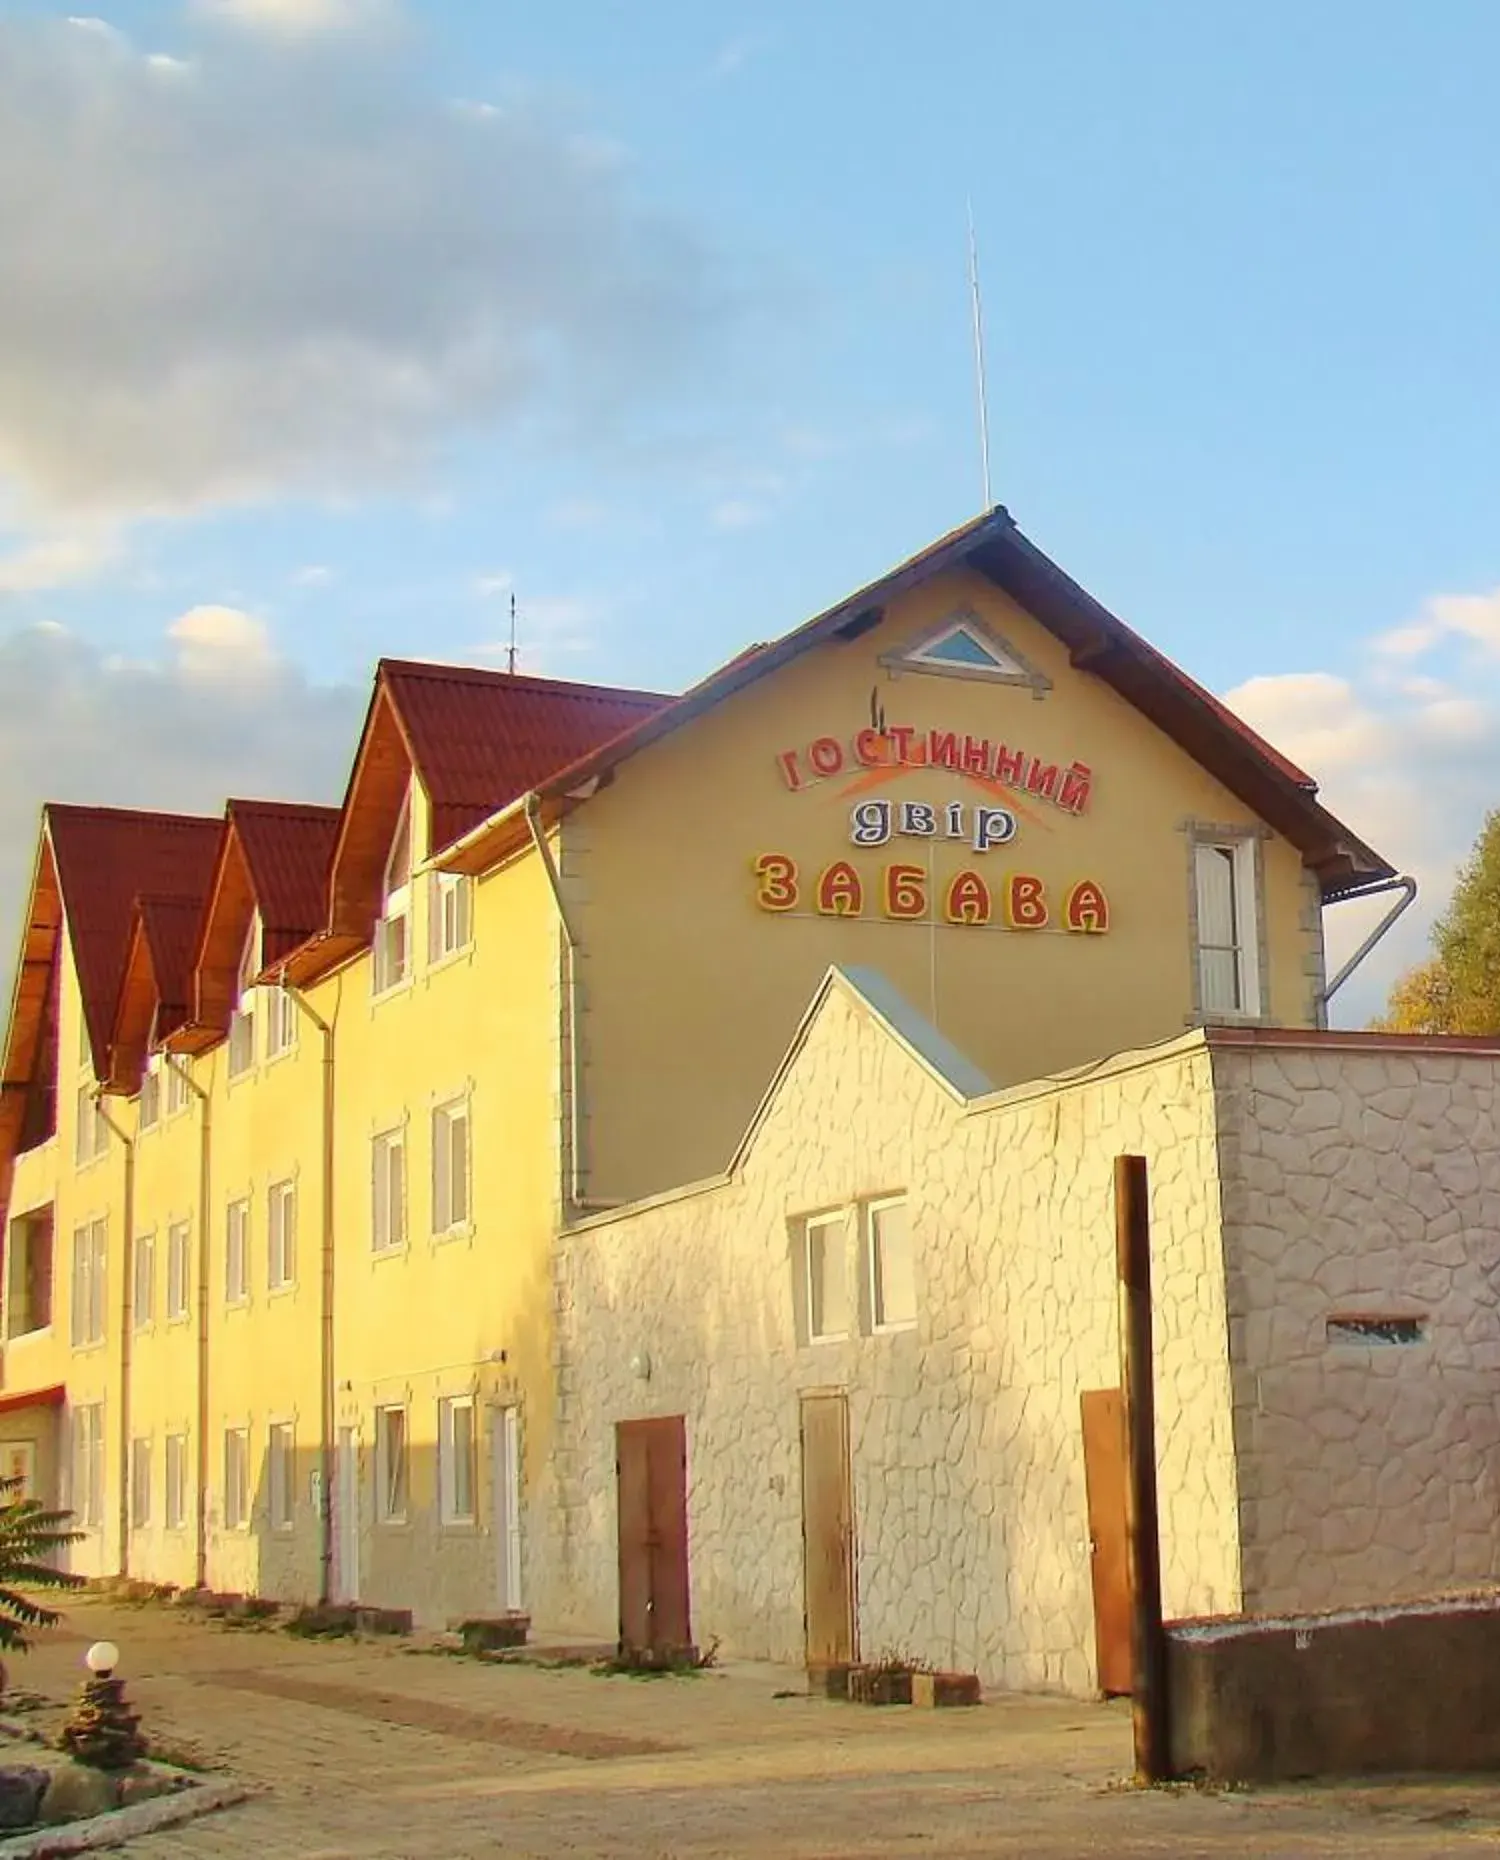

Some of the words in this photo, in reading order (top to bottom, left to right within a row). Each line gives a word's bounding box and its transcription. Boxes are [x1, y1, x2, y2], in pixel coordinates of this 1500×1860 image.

[777, 726, 1093, 815] ГОСТИННИЙ
[852, 800, 1017, 852] двір
[755, 853, 1110, 934] ЗАБАВА
